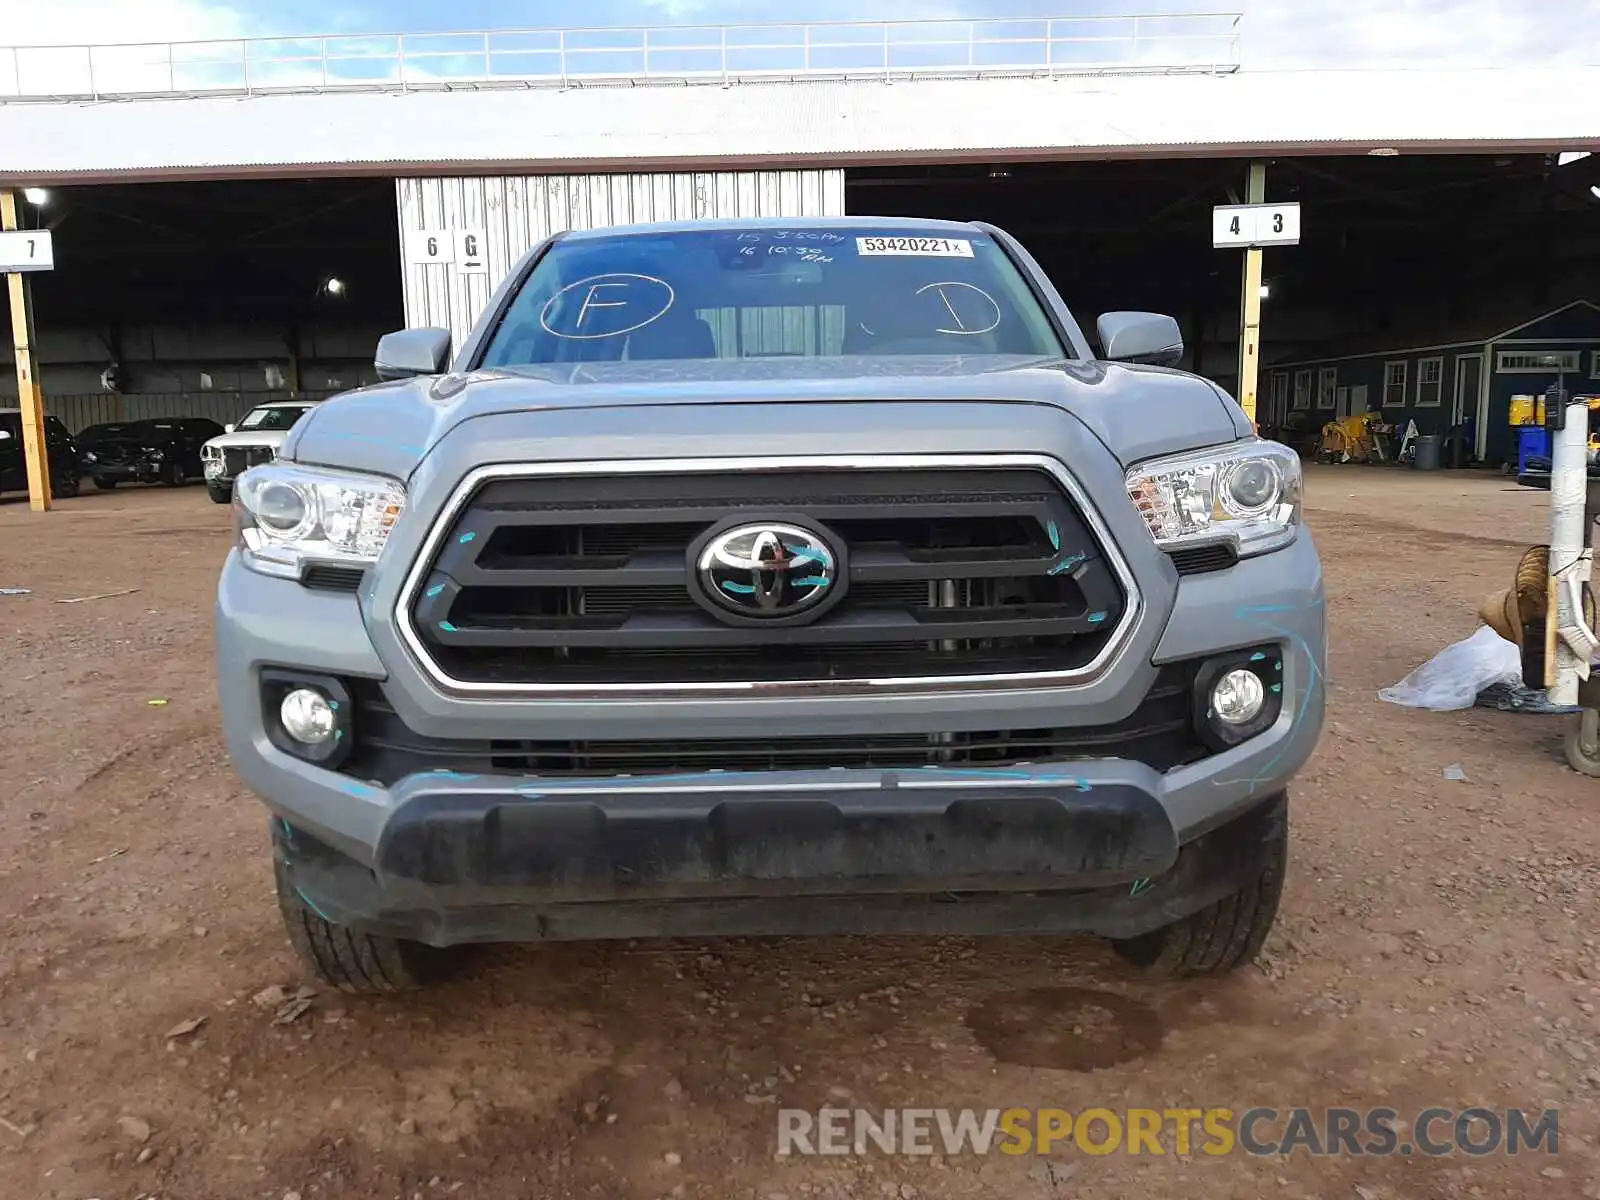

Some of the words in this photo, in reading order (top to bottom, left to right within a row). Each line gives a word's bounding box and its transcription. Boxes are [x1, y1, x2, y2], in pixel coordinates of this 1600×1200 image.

[1229, 215, 1240, 235] 4
[1273, 213, 1283, 233] 3
[27, 239, 35, 258] 7
[427, 237, 438, 256] 6
[464, 234, 477, 256] G
[576, 283, 630, 328] F
